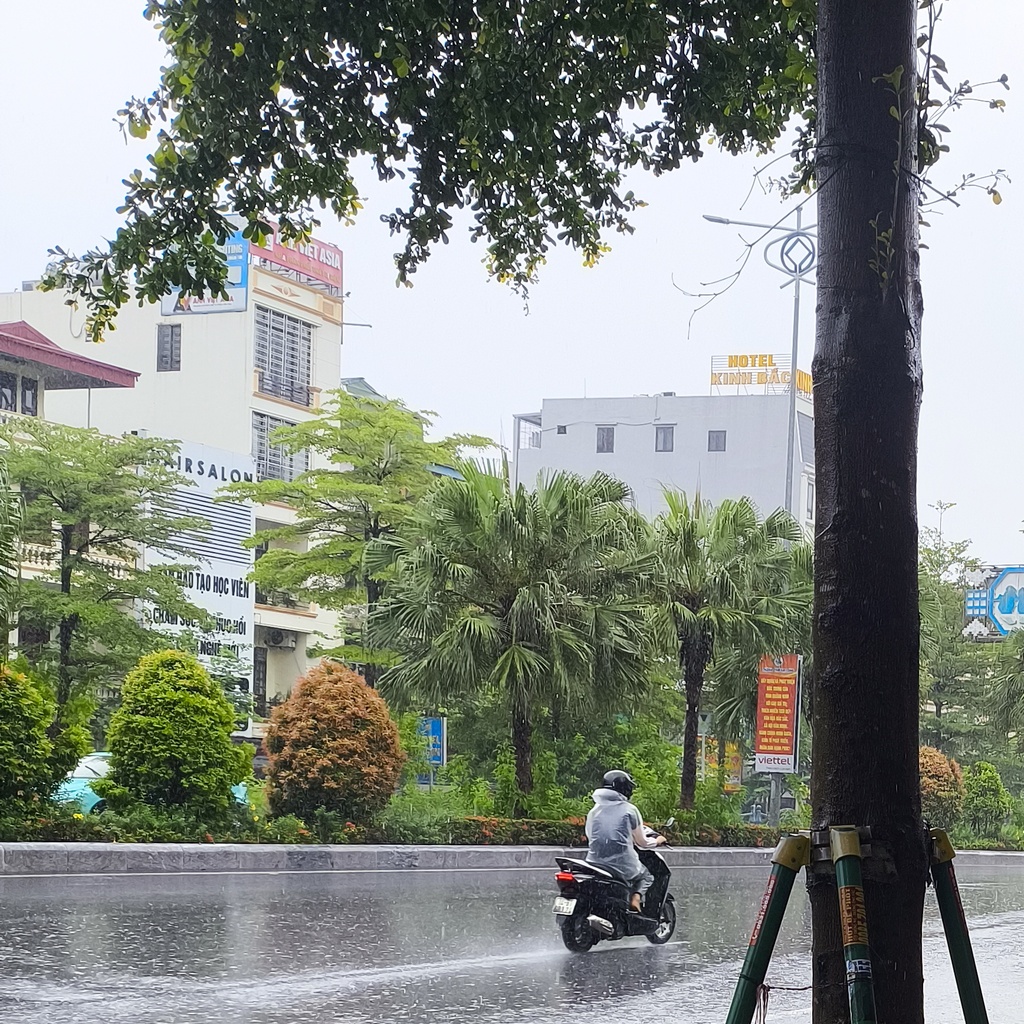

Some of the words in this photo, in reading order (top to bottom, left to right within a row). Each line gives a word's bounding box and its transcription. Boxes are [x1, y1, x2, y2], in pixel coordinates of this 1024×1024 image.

[319, 248, 340, 270] ASIA
[728, 354, 776, 368] HOTEL
[711, 372, 752, 385] KINH
[757, 368, 791, 385] BẮC
[213, 575, 229, 597] HỌC
[758, 757, 791, 765] viettel
